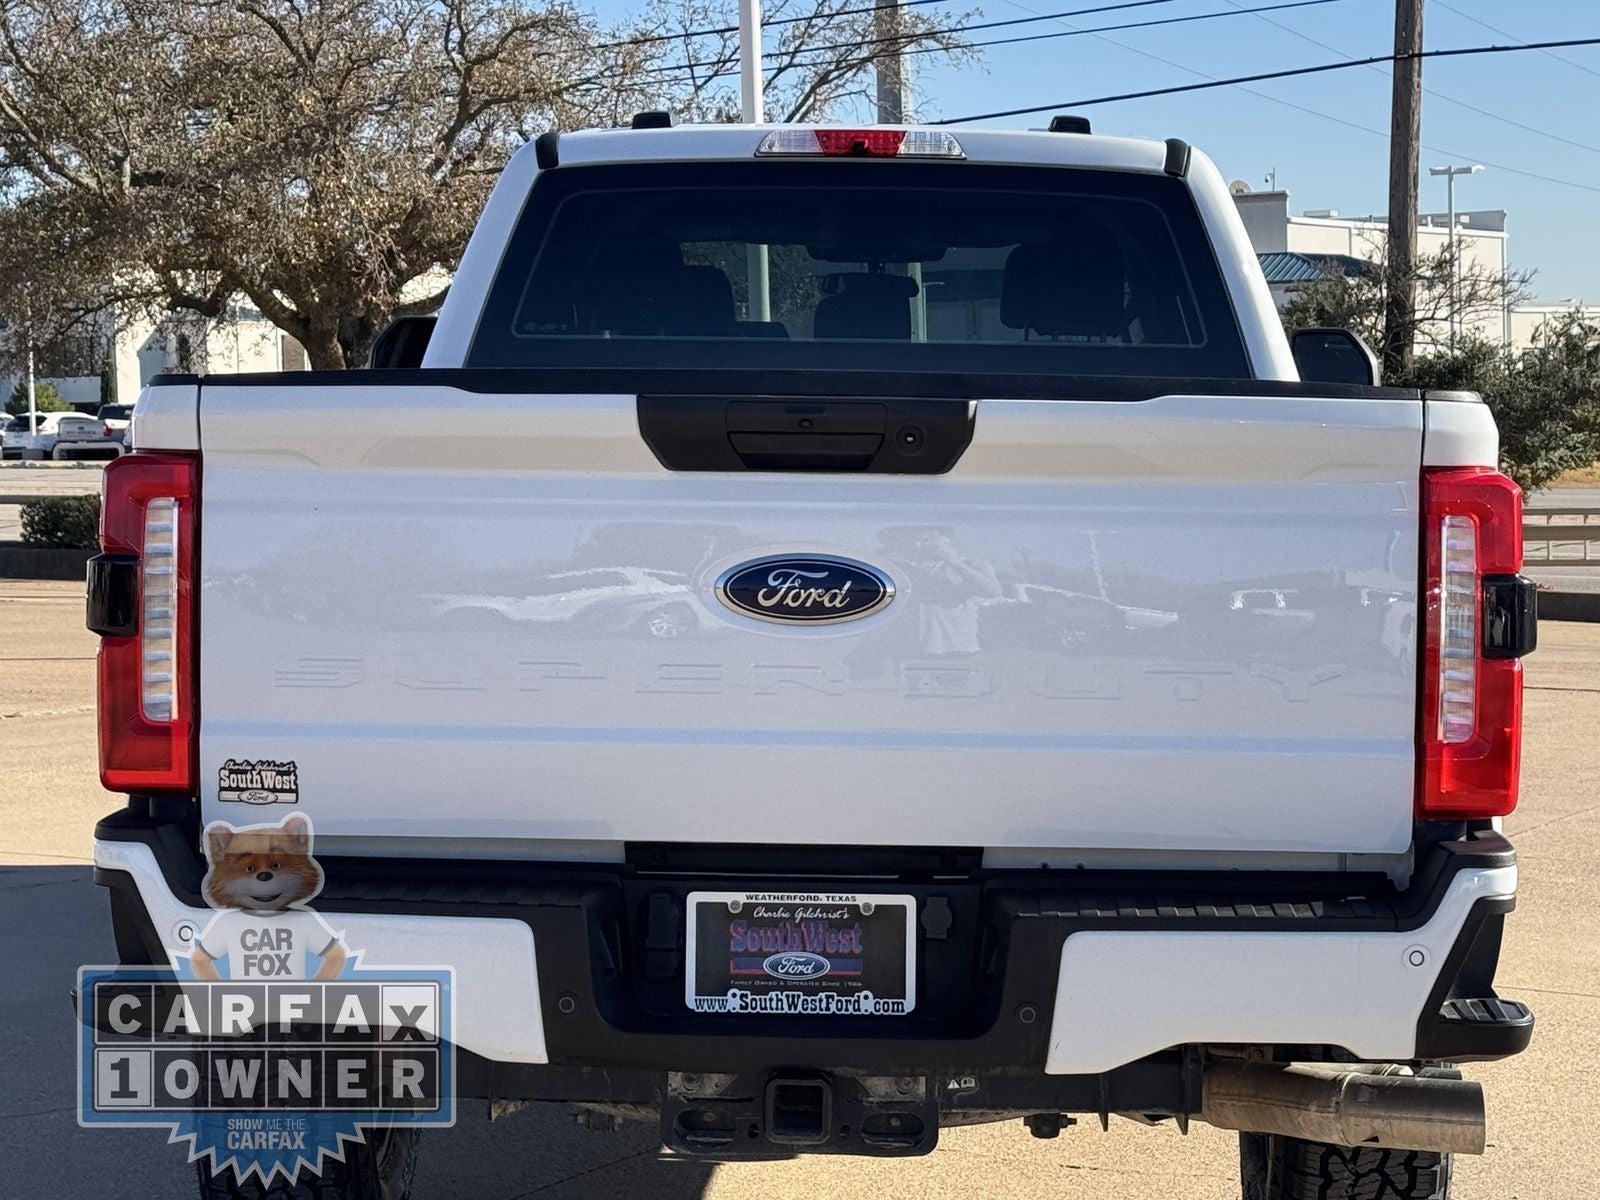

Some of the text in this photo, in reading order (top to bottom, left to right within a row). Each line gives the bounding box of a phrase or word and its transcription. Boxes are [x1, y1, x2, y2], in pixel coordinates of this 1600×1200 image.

[757, 569, 853, 608] Ford
[272, 656, 1348, 702] SUPER DUTY
[220, 770, 296, 789] SouthWest
[247, 792, 269, 801] Ford
[753, 907, 850, 923] Charlie Gilchrist's
[730, 920, 863, 953] SouthWest
[777, 957, 815, 974] Ford
[695, 993, 905, 1012] www.SouthWestFord.com
